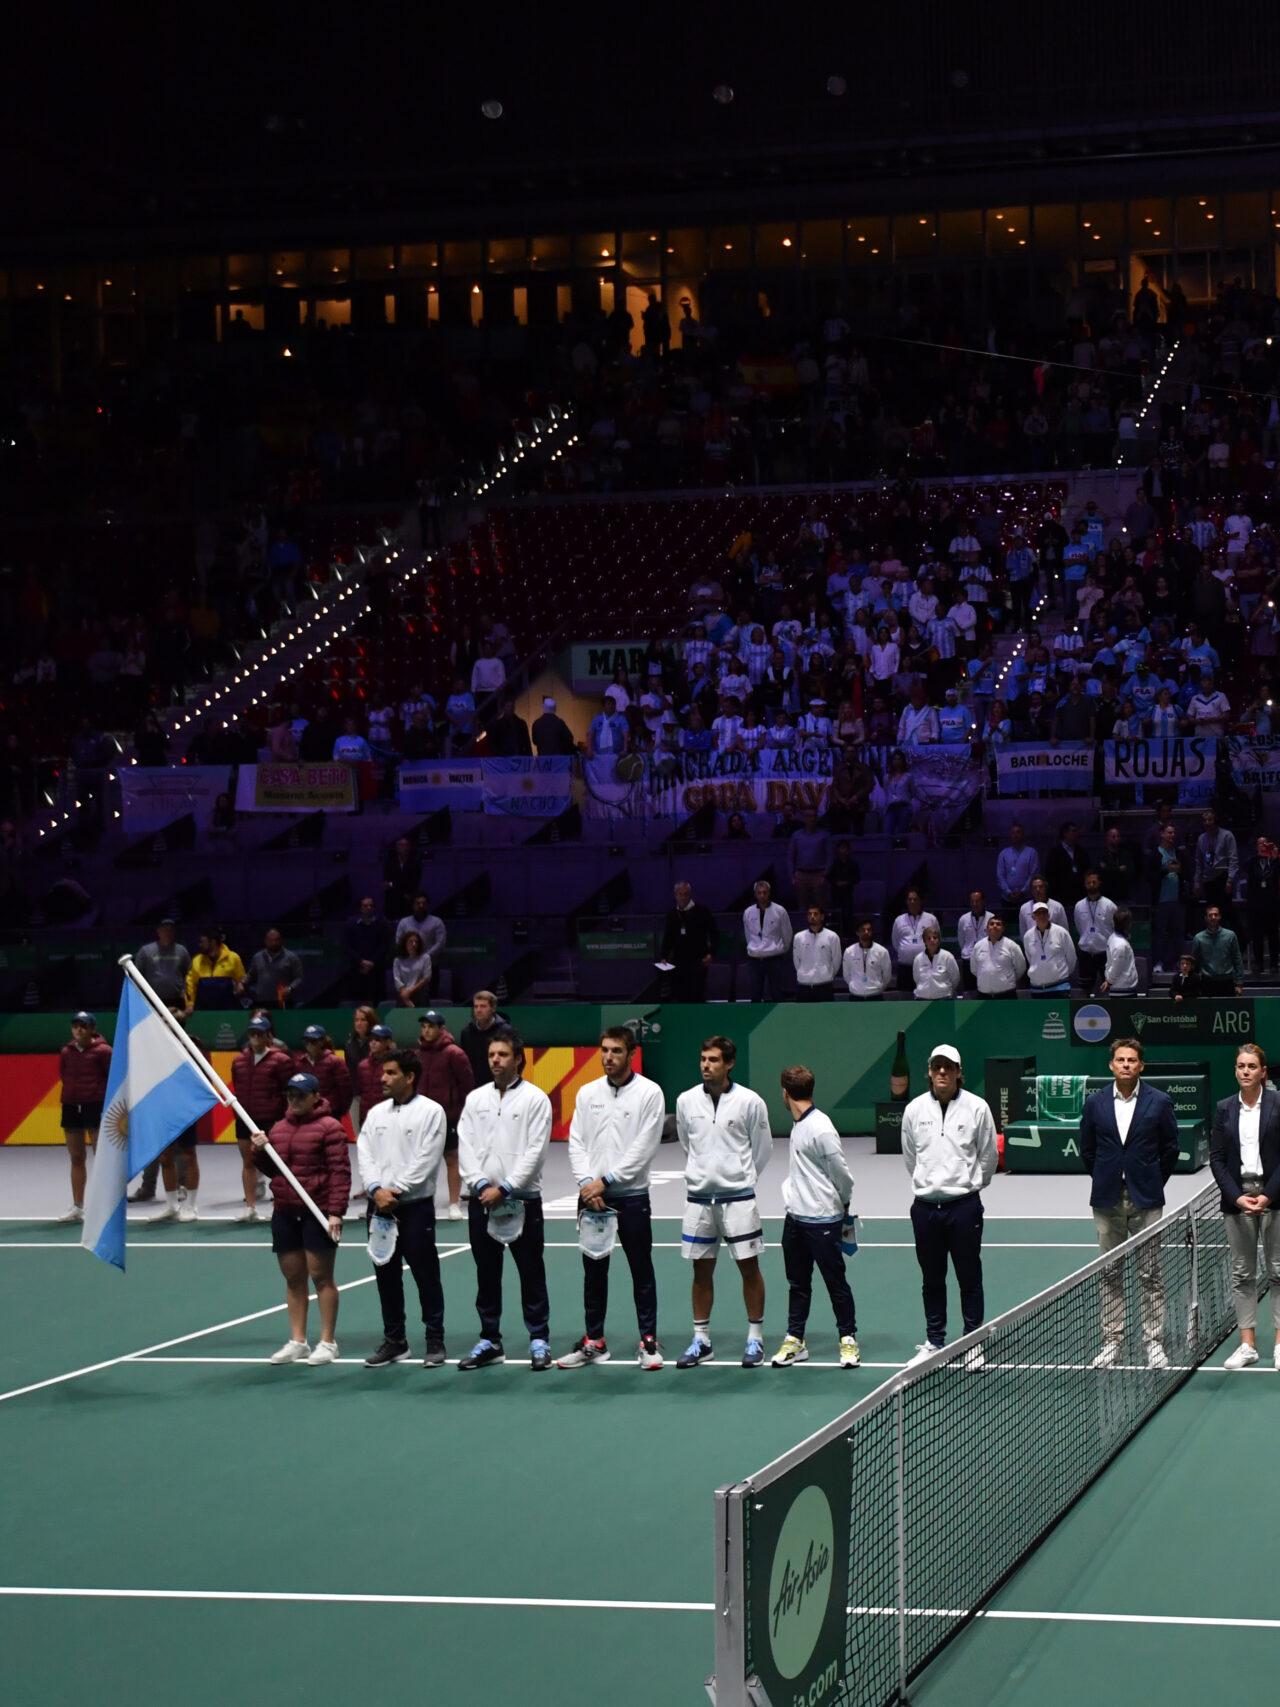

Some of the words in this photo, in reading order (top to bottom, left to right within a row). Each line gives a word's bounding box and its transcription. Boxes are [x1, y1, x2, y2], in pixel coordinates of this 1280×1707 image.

[588, 648, 645, 676] MAR
[1011, 754, 1088, 769] BARILOCHE
[1115, 737, 1207, 778] ROJAS
[260, 768, 300, 786] CASA
[307, 767, 348, 785] BETO
[1147, 1014, 1161, 1025] San
[1162, 1014, 1197, 1025] Cristóbal
[1212, 1010, 1250, 1034] ARG
[1167, 1084, 1197, 1093] Adecco
[1000, 1087, 1009, 1127] APFRE
[1173, 1102, 1197, 1111] decco
[773, 1539, 829, 1638] AirAsia
